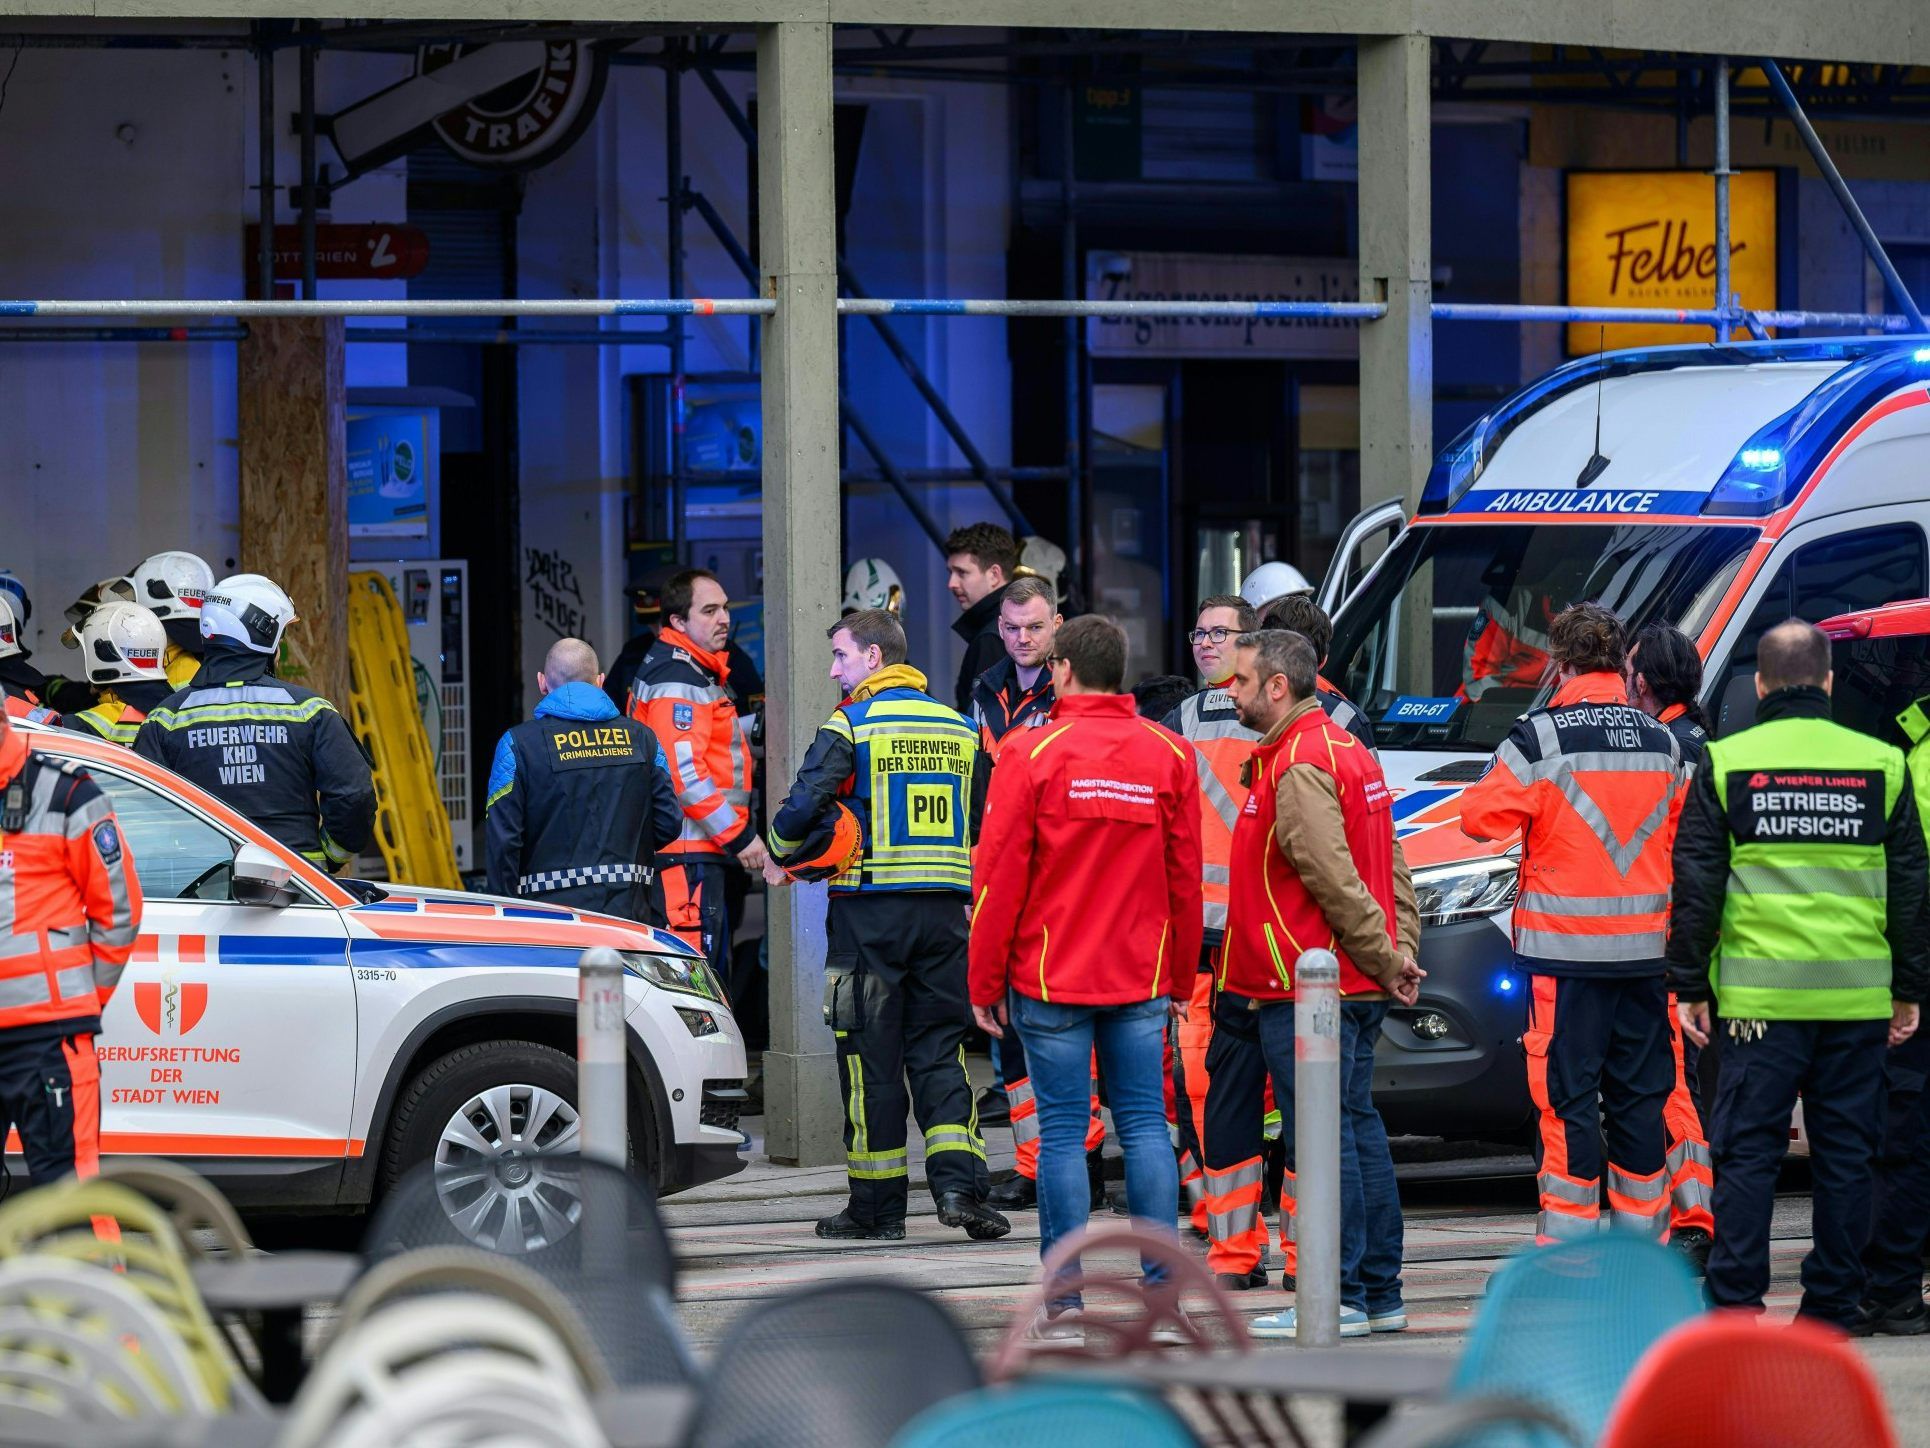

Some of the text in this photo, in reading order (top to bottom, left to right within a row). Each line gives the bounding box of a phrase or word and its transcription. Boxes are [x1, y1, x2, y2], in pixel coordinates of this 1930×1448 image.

[464, 42, 574, 148] TRAFIK
[1485, 492, 1660, 513] AMBULANCE
[127, 649, 157, 658] FEUER
[1397, 703, 1449, 716] BRI-6T
[187, 724, 288, 749] FEUERWEHR
[553, 728, 632, 751] POLIZEI
[1605, 729, 1642, 748] WIEN
[223, 745, 258, 765] KHD
[560, 748, 633, 761] KRIMINALDIENST
[891, 739, 960, 757] FEUERWEHR
[218, 764, 265, 785] WIEN
[877, 756, 971, 776] DER STADT WIEN
[1774, 775, 1867, 788] WIENER LINIEN
[913, 795, 948, 824] PIO
[1752, 792, 1866, 813] BETRIEBS-
[1755, 816, 1863, 838] AUFSICHT
[357, 969, 397, 981] 3315-70
[97, 1047, 240, 1063] BERUFSRETTUNG
[151, 1068, 183, 1083] DER
[112, 1089, 219, 1104] STADT WIEN
